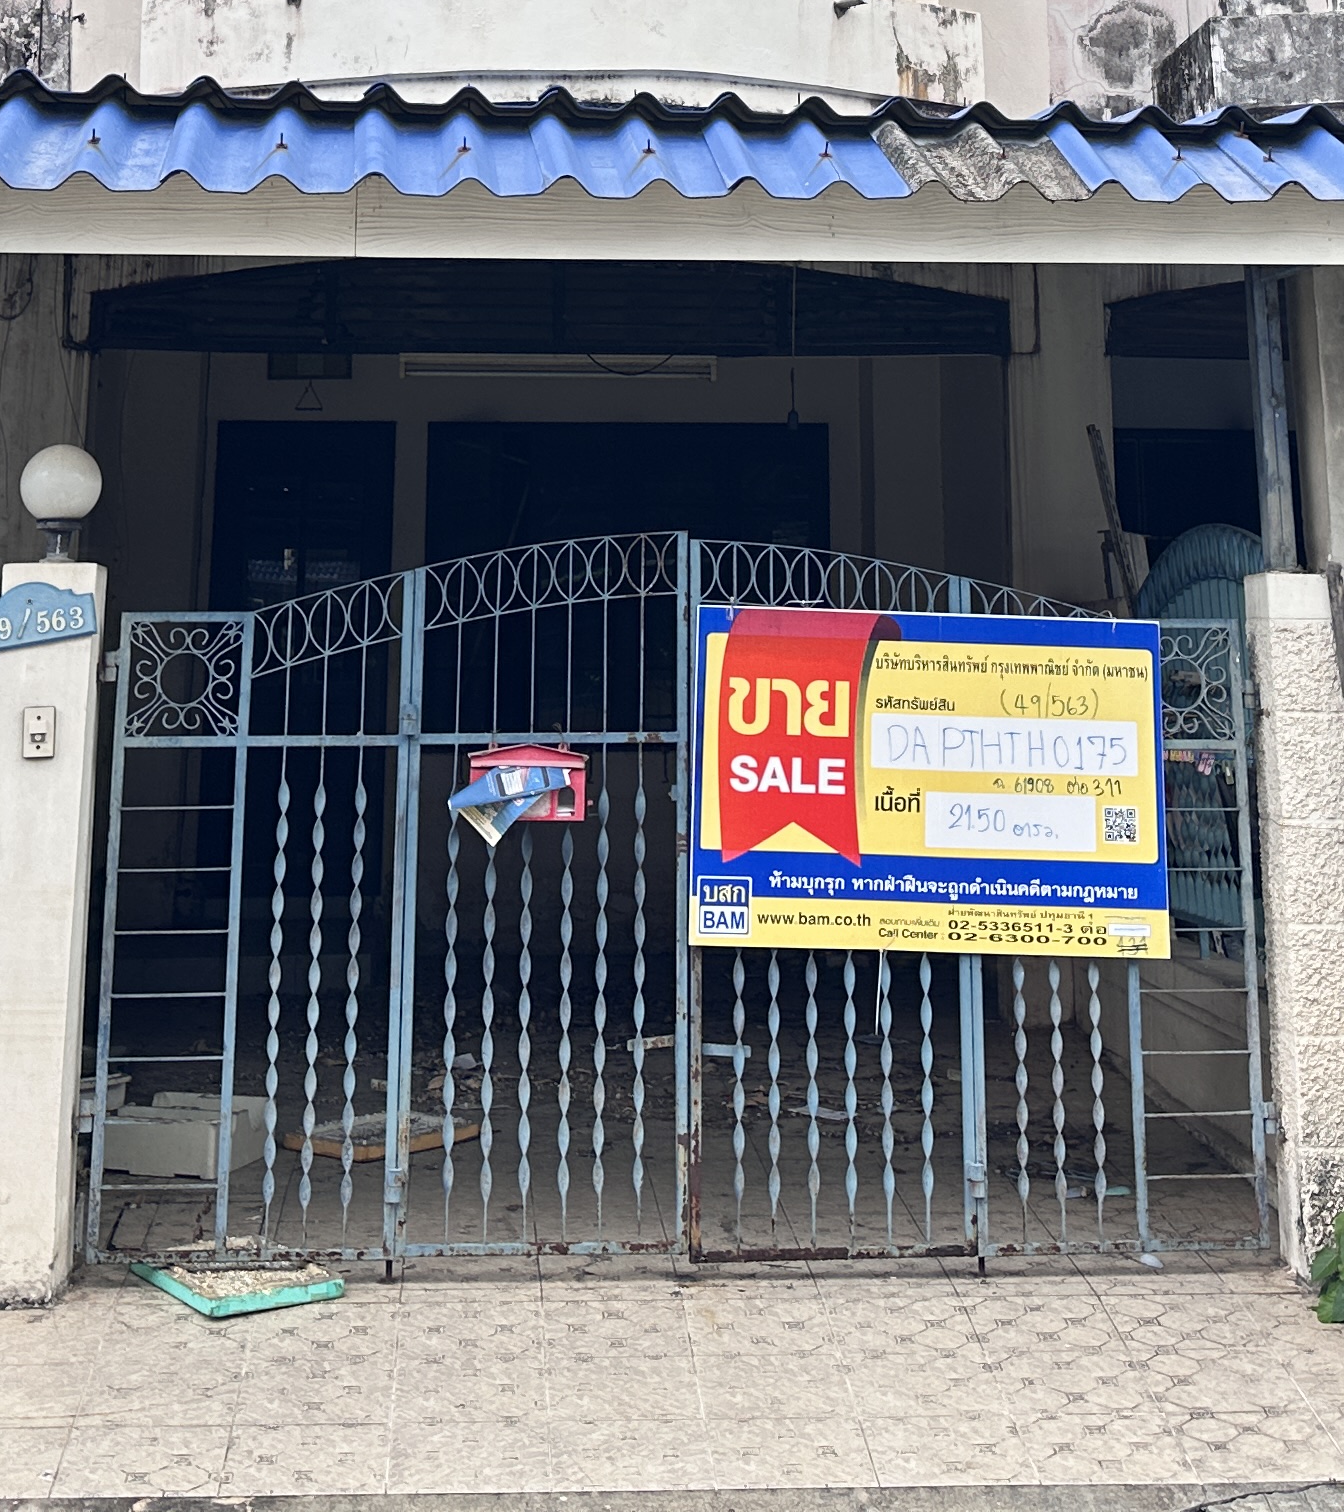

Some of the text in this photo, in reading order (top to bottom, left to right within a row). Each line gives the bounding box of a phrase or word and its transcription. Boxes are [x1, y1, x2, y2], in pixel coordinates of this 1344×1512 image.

[875, 653, 1148, 681] บริษัทบริหารสินทรัพย์ กรุงเทพพาณิชย์ จำกัด (มหาชน)
[728, 676, 850, 738] ขาย
[875, 695, 956, 712] รหัสทรัพย์สิน
[1000, 682, 1099, 719] (49/563)
[729, 754, 846, 795] SALE
[875, 785, 921, 813] เนื้อที่
[703, 884, 746, 903] บสก
[769, 870, 1138, 903] ห้ามบุกรุก หากฝ่าฝืนจะถูกดำเนินคดีตามกฎหมาย
[703, 911, 746, 929] BAM
[757, 912, 871, 927] www.bam.co.th
[948, 919, 1074, 934] 02-5336511-3
[878, 928, 1107, 945] Call Center 02-6300-700
